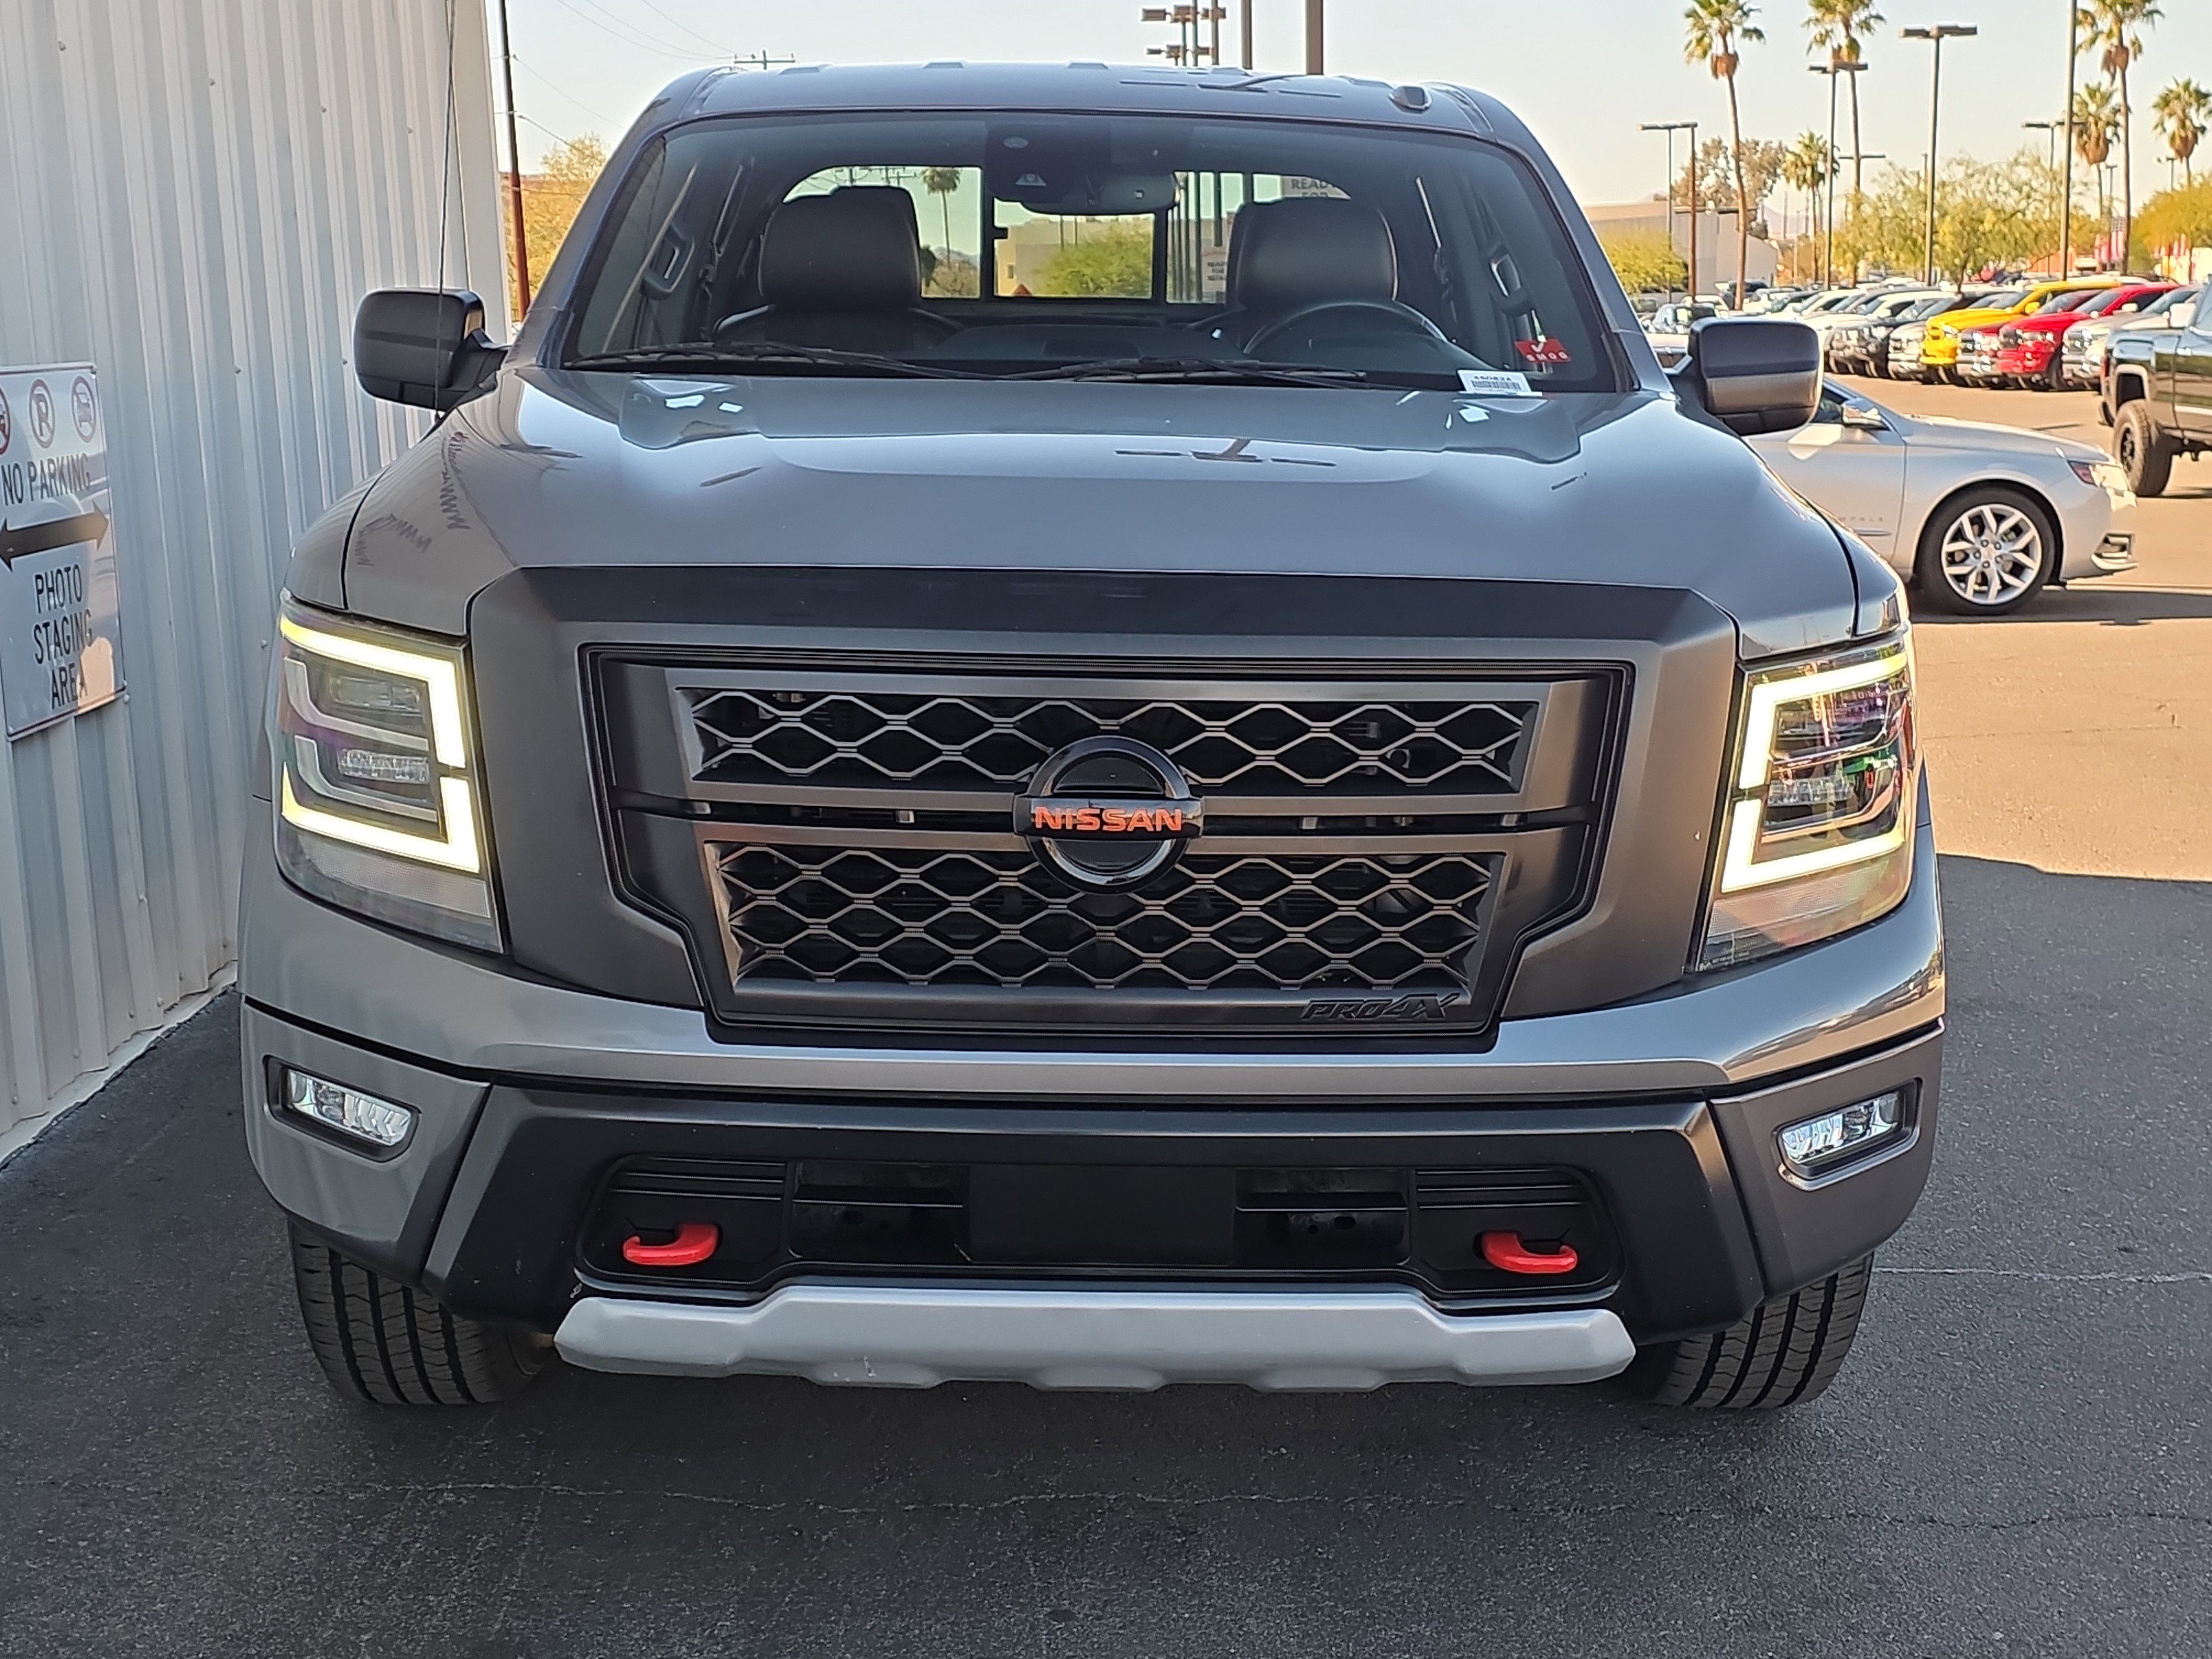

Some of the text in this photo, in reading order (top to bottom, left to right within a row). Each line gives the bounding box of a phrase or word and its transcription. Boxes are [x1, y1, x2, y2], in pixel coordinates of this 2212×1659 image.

[1, 452, 91, 506] NO PARKING
[35, 564, 82, 613] PHOTO
[34, 609, 92, 664] STAGING
[52, 654, 88, 710] AREA
[1035, 806, 1182, 831] NISSAN
